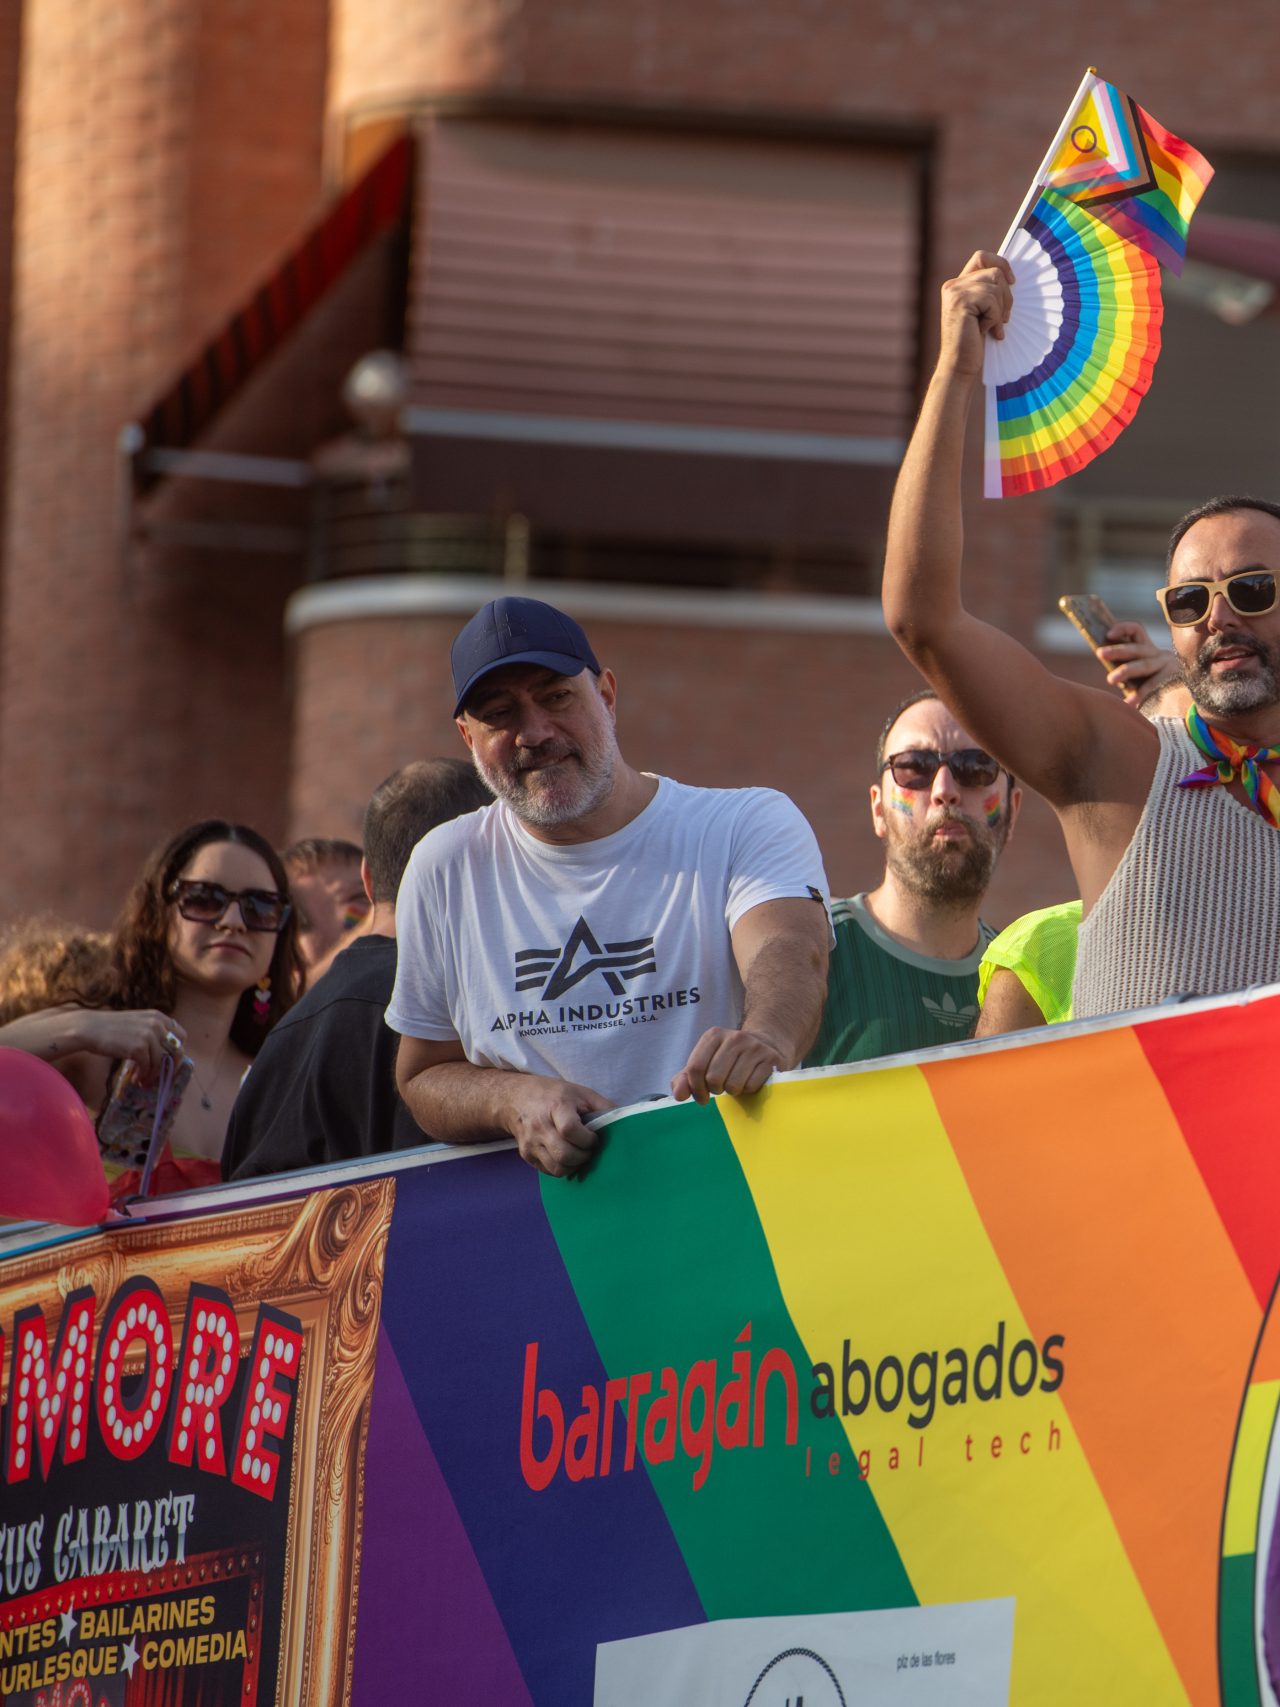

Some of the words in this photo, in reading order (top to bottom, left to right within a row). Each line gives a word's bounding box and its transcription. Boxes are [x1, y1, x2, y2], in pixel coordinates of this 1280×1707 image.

[518, 1024, 569, 1038] KNOXVILLE,
[571, 1019, 626, 1032] TENNESSEE,
[559, 987, 701, 1022] INDUSTRIES
[0, 1278, 304, 1501] MORE
[519, 1320, 800, 1492] barragán
[808, 1321, 1067, 1430] abogados
[805, 1436, 925, 1480] legal
[964, 1420, 1062, 1462] tech
[53, 1490, 197, 1582] CABARET
[79, 1595, 216, 1640] BAILARINES
[0, 1645, 118, 1695] URLESQUE
[142, 1629, 248, 1671] COMEDIA
[909, 1652, 920, 1669] de
[921, 1651, 933, 1667] las
[934, 1649, 956, 1666] flores
